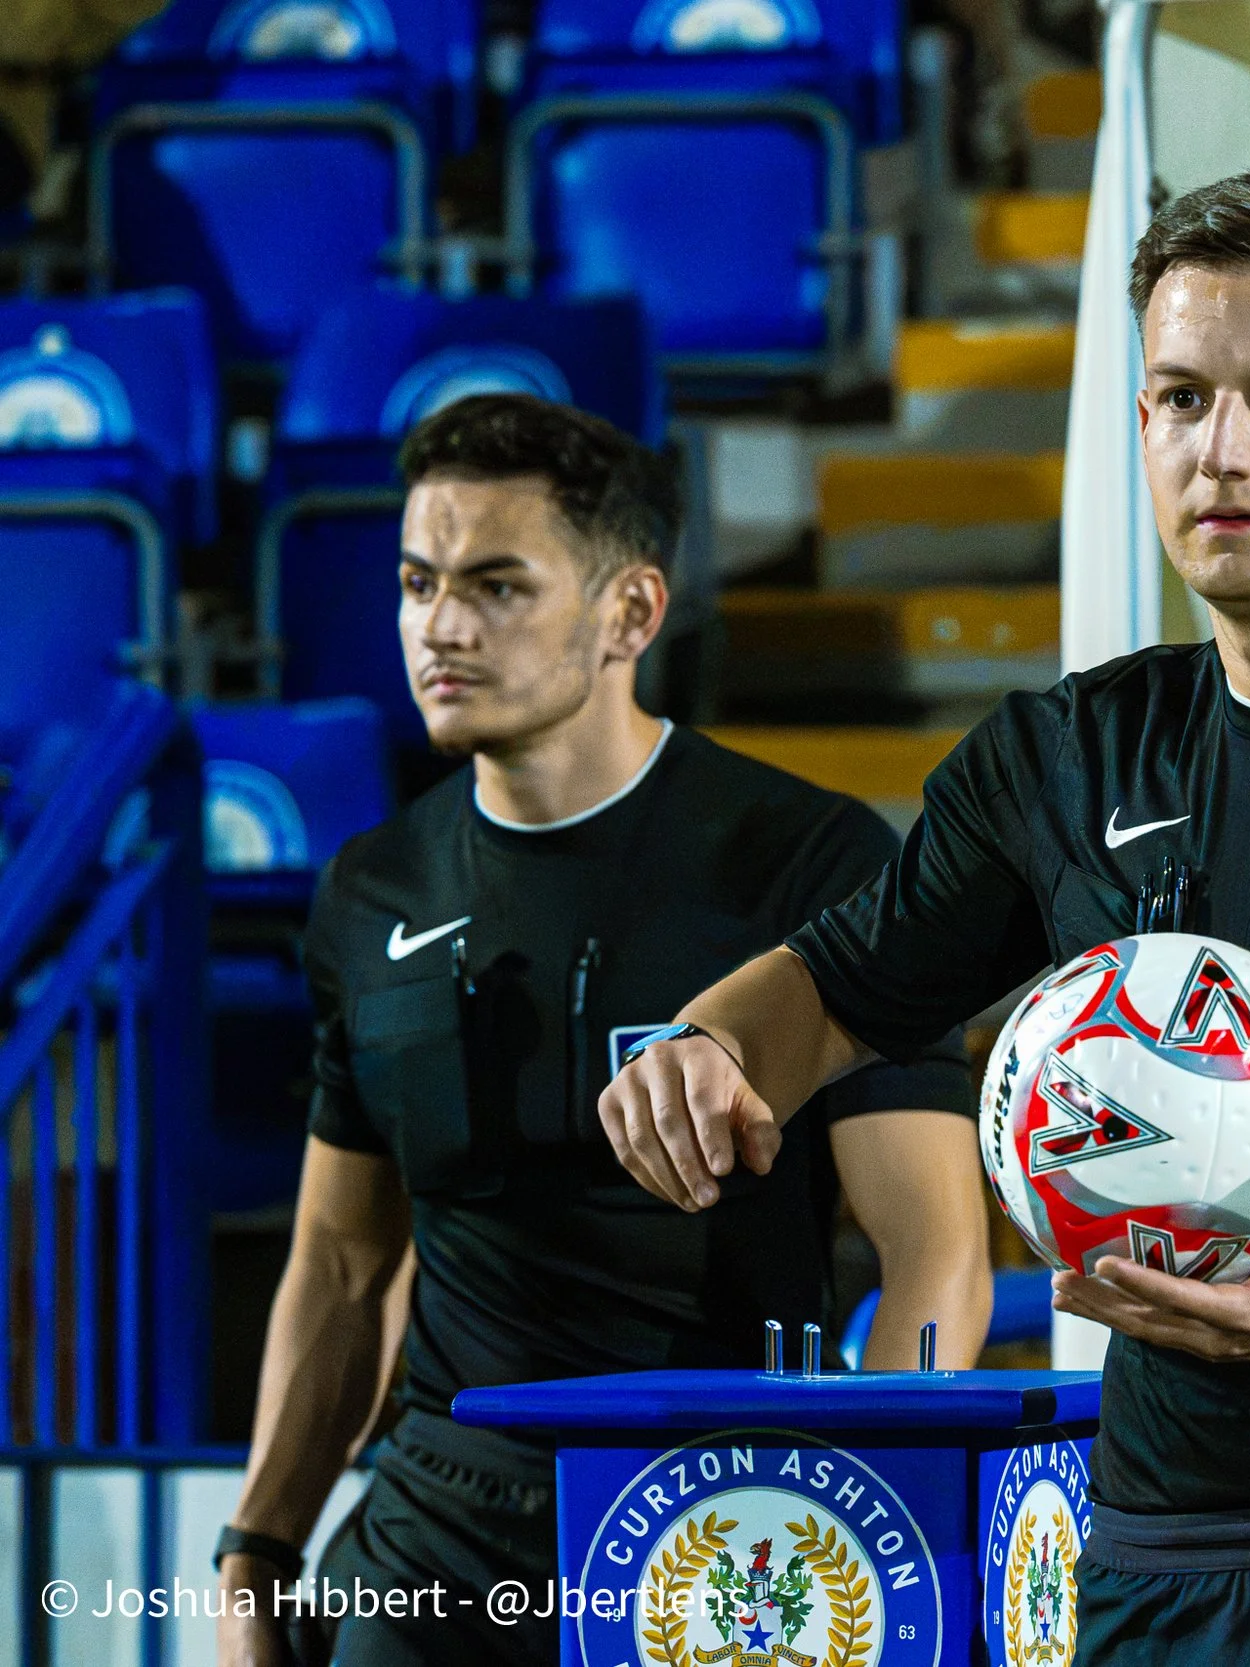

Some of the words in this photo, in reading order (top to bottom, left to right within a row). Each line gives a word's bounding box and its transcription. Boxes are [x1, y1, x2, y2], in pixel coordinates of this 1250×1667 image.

[992, 1444, 1042, 1567] CURZON
[1048, 1442, 1092, 1541] ASHTO
[605, 1444, 755, 1566] CURZON
[778, 1448, 920, 1591] ASHTON
[992, 1610, 1000, 1625] 19
[898, 1624, 916, 1640] 63
[706, 1645, 737, 1663] LABOR
[739, 1656, 772, 1666] OMNIA
